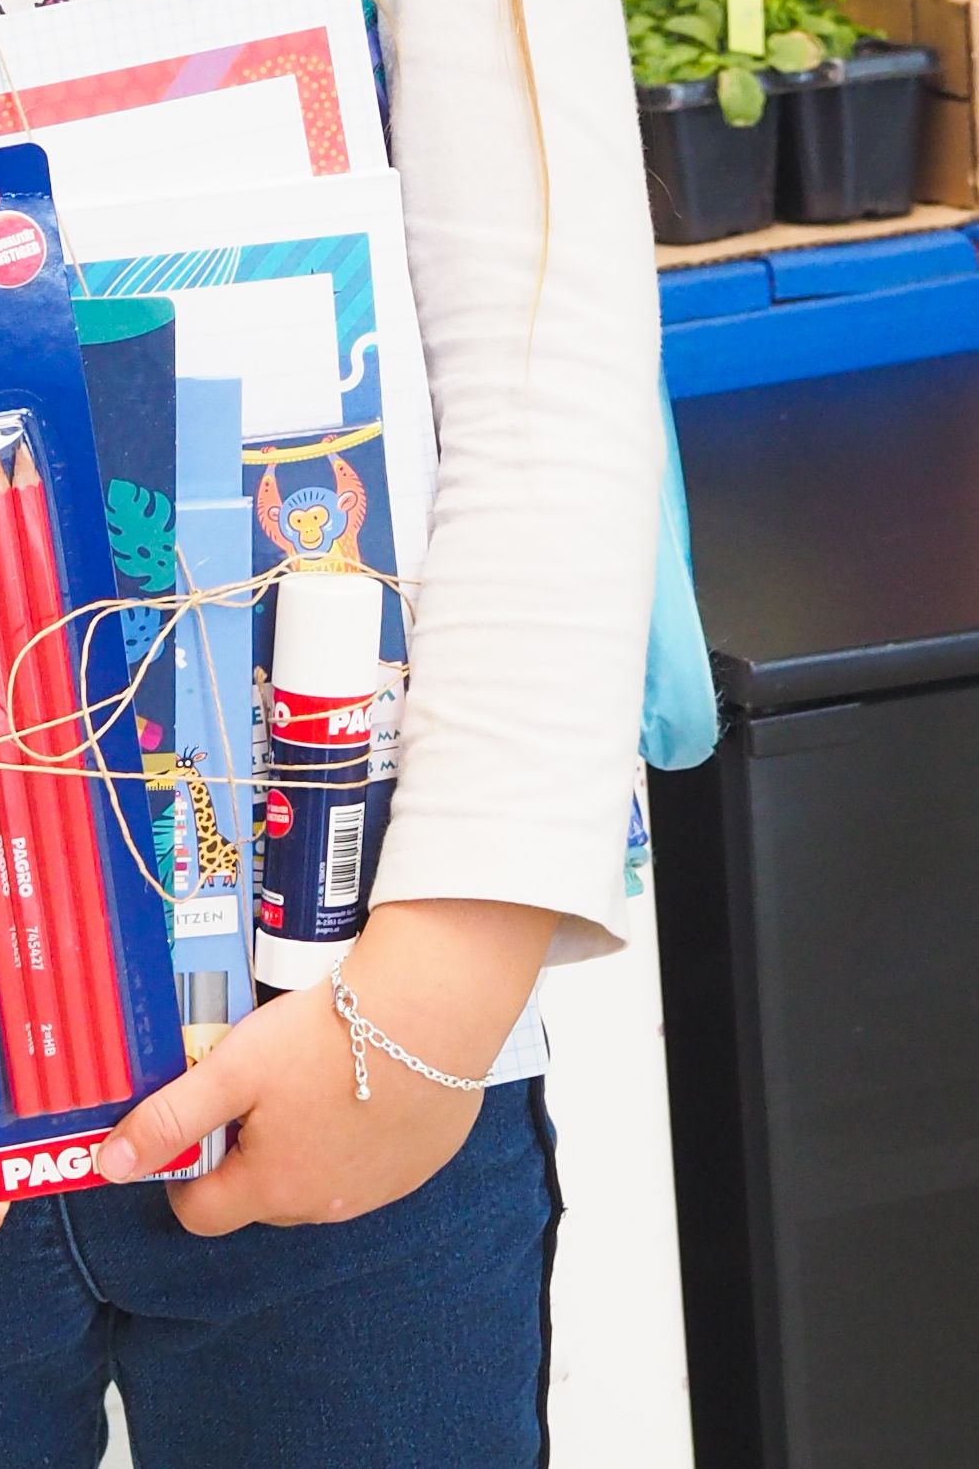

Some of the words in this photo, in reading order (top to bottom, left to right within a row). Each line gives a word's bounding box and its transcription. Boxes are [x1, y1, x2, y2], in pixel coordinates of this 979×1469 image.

[11, 836, 34, 898] PAGRO
[26, 925, 45, 971] 745427
[176, 910, 223, 926] ITZEN
